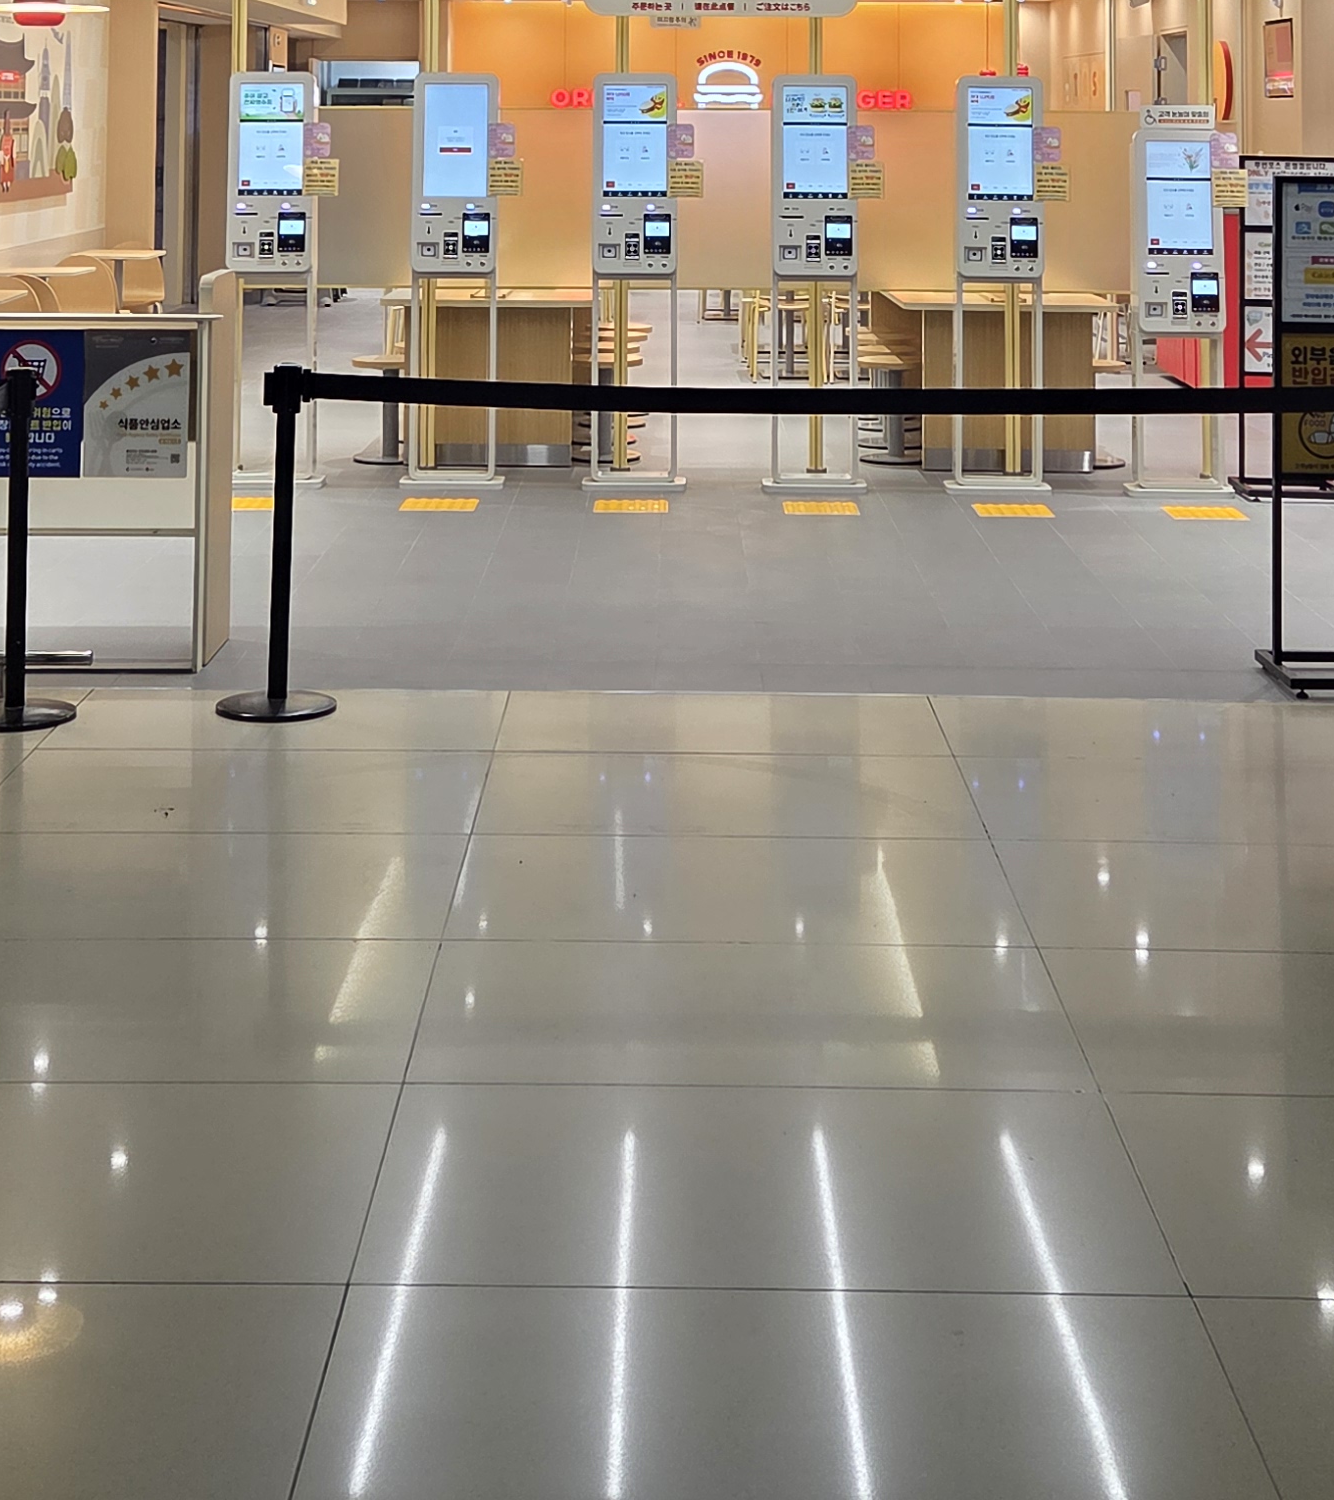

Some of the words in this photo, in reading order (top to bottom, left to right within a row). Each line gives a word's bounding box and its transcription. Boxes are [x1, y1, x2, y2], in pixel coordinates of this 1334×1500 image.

[632, 2, 663, 12] 주문하는
[755, 2, 811, 12] ご注文はこちら
[696, 49, 734, 67] SINCE
[736, 50, 762, 68] 1979
[117, 418, 182, 431] 식품안심업소
